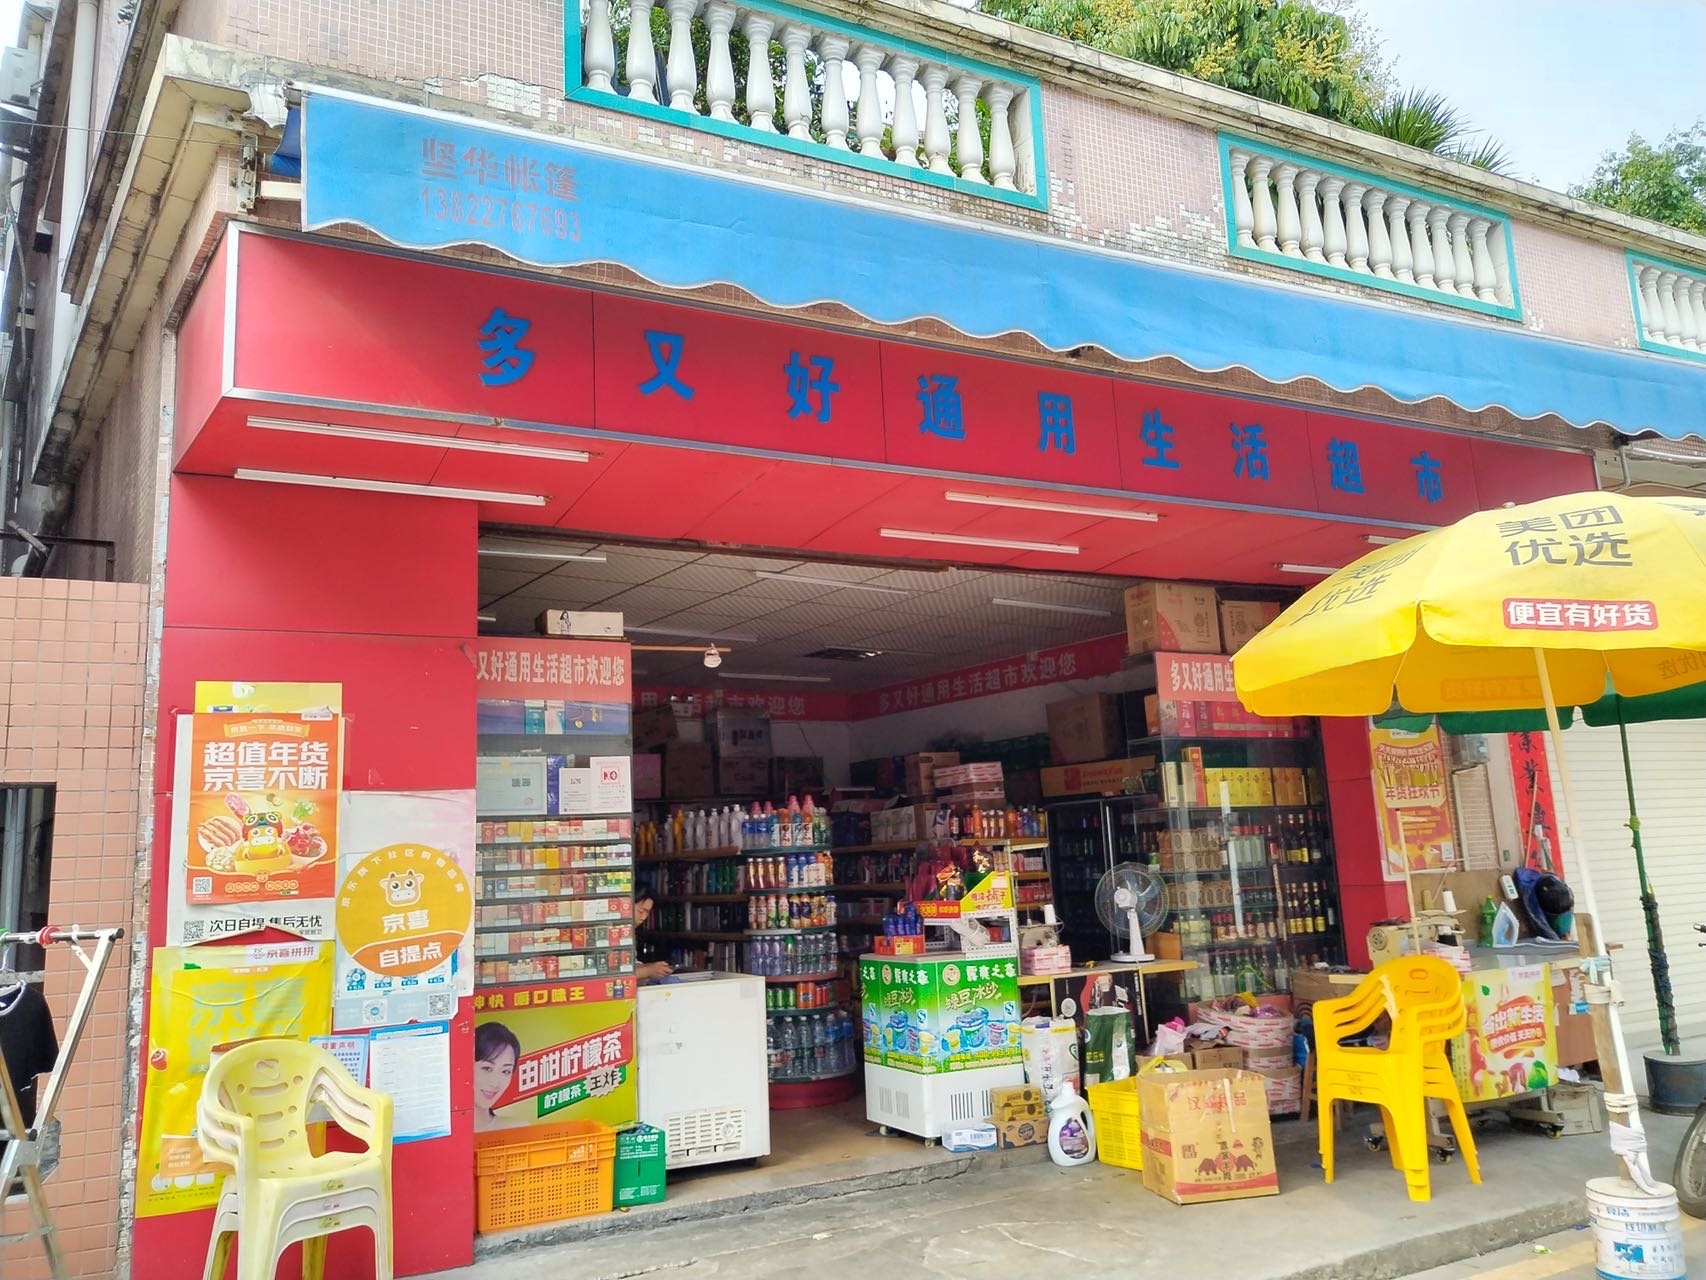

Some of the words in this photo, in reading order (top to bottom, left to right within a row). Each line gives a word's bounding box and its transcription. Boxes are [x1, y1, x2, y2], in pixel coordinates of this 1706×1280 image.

[477, 307, 1445, 503] 多又好通用生活超市
[1496, 505, 1625, 538] 美团
[1504, 530, 1634, 567] 优选
[1507, 601, 1654, 628] 便宜有好货
[476, 651, 625, 687] 又好通用生活超市欢迎您
[878, 652, 1077, 714] 多又好通用生活超市欢迎您
[1170, 659, 1235, 693] 多又好通用生
[203, 741, 329, 767] 超值年货
[203, 766, 328, 792] 京喜不断
[381, 909, 430, 934] 京喜
[379, 941, 443, 968] 自提点
[518, 1030, 623, 1092] 由柑柠檬茶
[544, 1084, 581, 1108] 柠檬茶
[590, 1069, 618, 1091] 王炸
